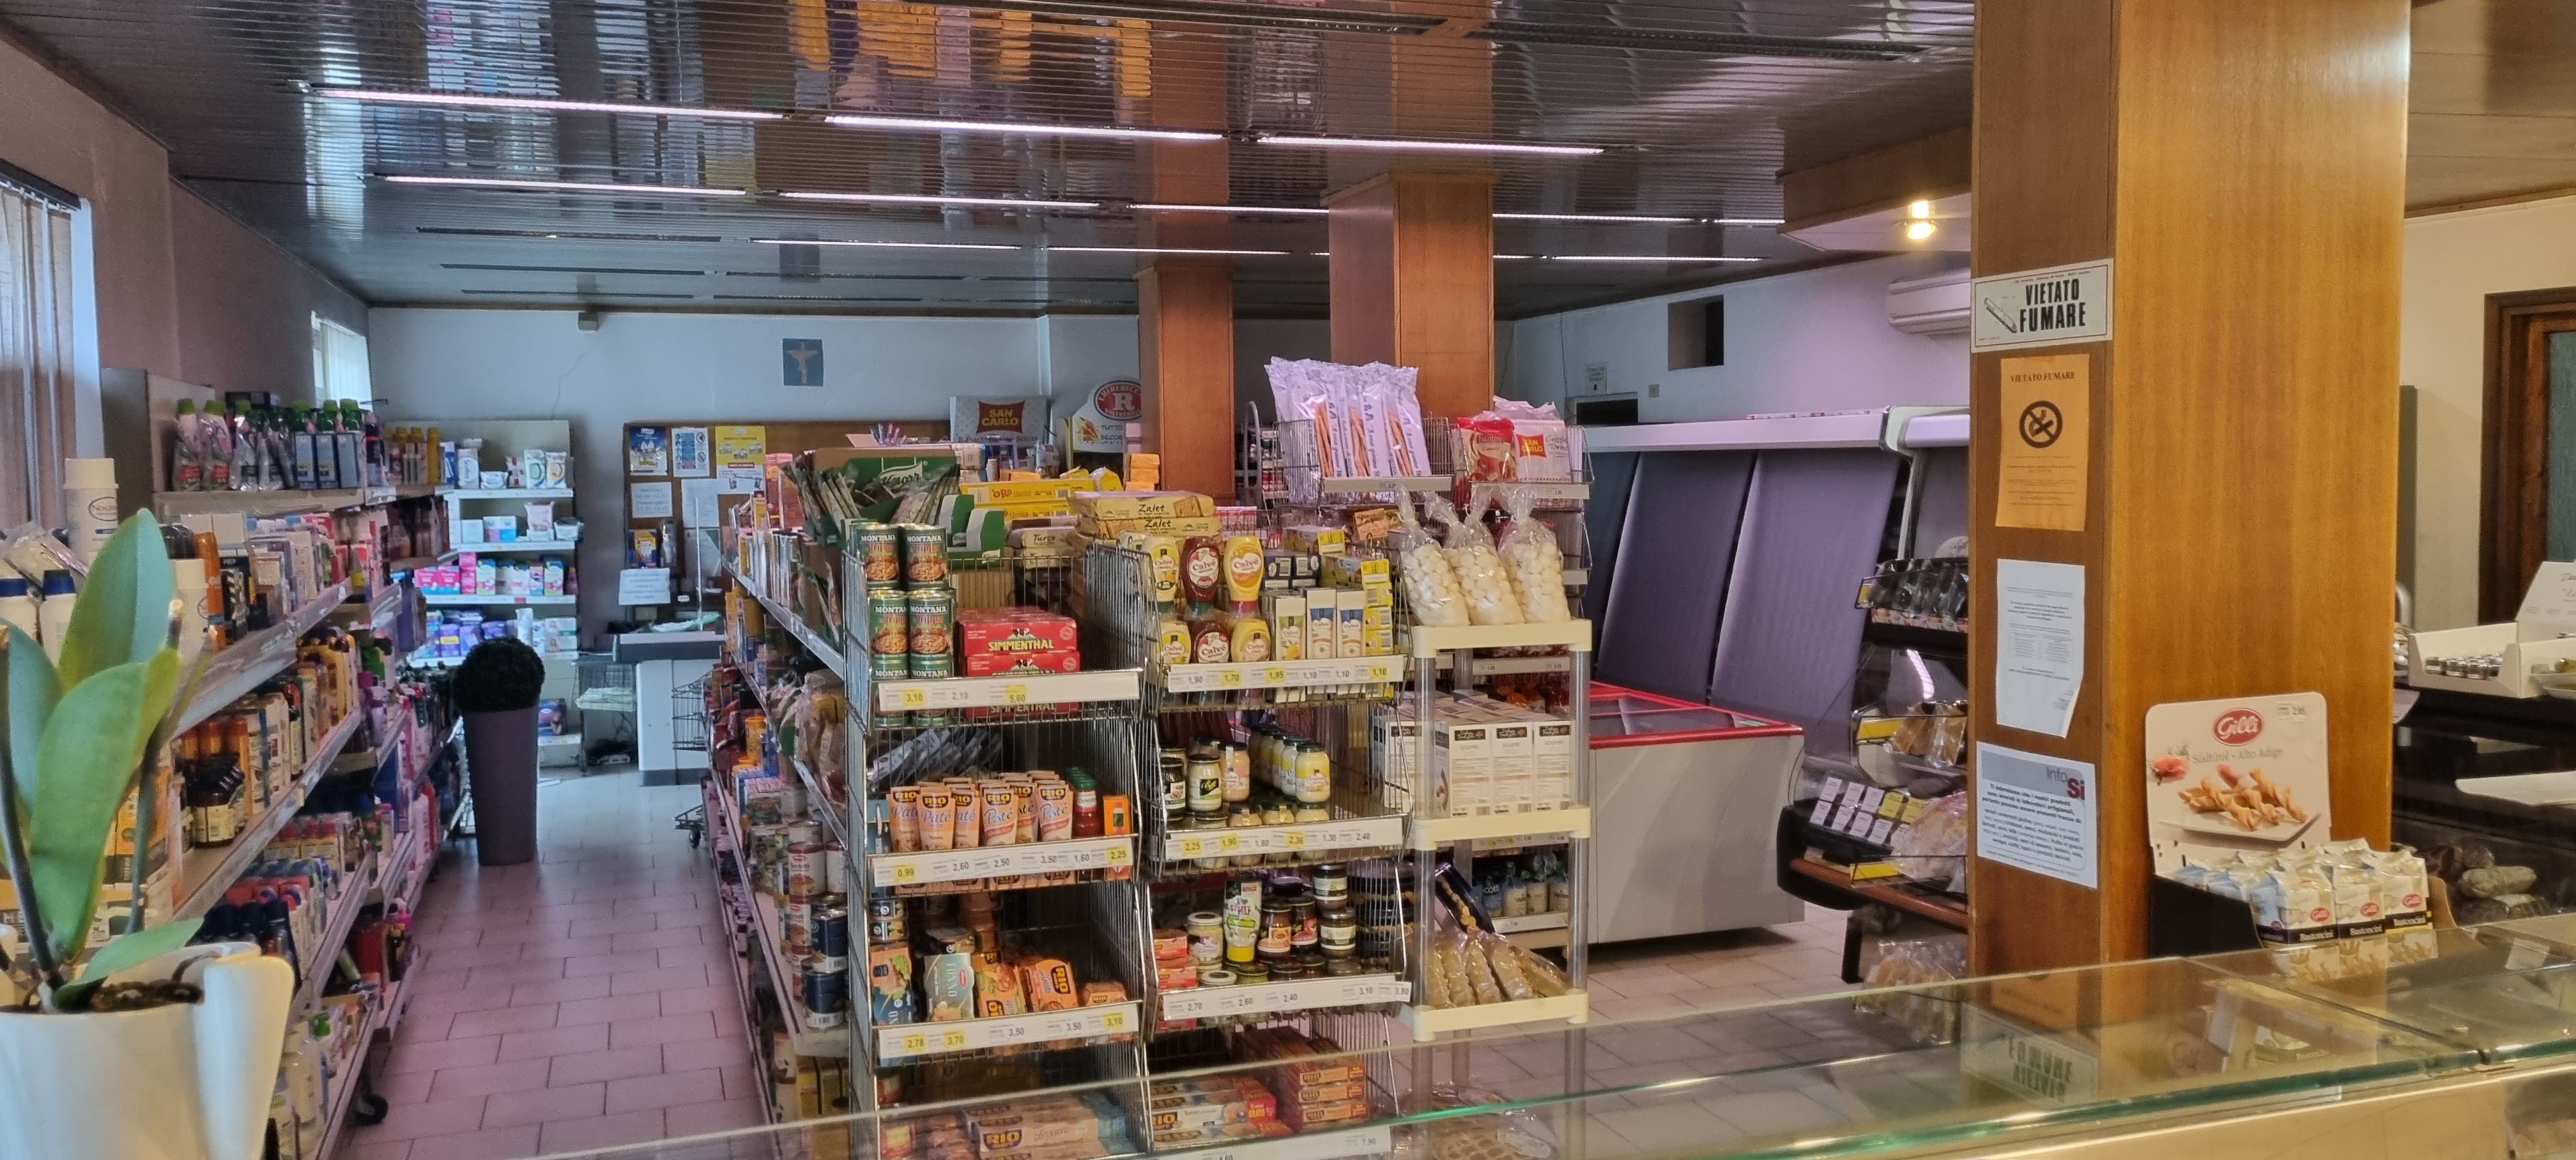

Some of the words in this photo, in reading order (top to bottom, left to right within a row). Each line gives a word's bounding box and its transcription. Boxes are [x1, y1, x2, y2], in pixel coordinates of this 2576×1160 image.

[2025, 279, 2080, 306] VIETATO
[2020, 302, 2086, 333] FUMARE
[2011, 374, 2043, 382] VIETATO
[2044, 371, 2075, 381] FUMARE
[1113, 392, 1135, 410] R
[990, 409, 1013, 417] SAN
[982, 418, 1019, 426] CARLO
[1138, 504, 1165, 512] Zalet
[1144, 519, 1172, 528] Zalet
[1192, 560, 1216, 571] Calvé
[1234, 558, 1259, 569] Calvé
[988, 639, 1054, 652] SIMMENTHAL
[1202, 643, 1226, 655] Calvé
[913, 669, 948, 678] MONTANA
[1188, 676, 1203, 684] 1,90
[907, 694, 923, 702] 3,10
[1010, 694, 1025, 703] 5,60
[2218, 715, 2259, 739] Gilli
[2046, 767, 2067, 783] Info
[2067, 777, 2085, 800] Si
[891, 806, 918, 818] Pat
[1018, 800, 1034, 814] até
[1040, 802, 1068, 820] Paté
[921, 810, 951, 823] Paté
[956, 809, 976, 821] até
[985, 807, 1013, 825] Paté
[898, 868, 914, 878] 0,99
[953, 861, 969, 871] 2,60
[995, 858, 1010, 868] 2,50
[1041, 855, 1057, 864] 3,50
[1075, 853, 1090, 862] 1,60
[1111, 850, 1126, 859] 2,25
[2301, 931, 2333, 941] Bastoncini
[2350, 924, 2382, 936] Bastoncini
[1055, 967, 1070, 993] RIO
[908, 1038, 924, 1048] 2,78
[947, 1036, 963, 1045] 3,70
[1009, 1027, 1024, 1037] 3,50
[1066, 1022, 1082, 1032] 3,50
[1107, 1017, 1123, 1026] 3,10
[987, 1132, 1020, 1144] RIO
